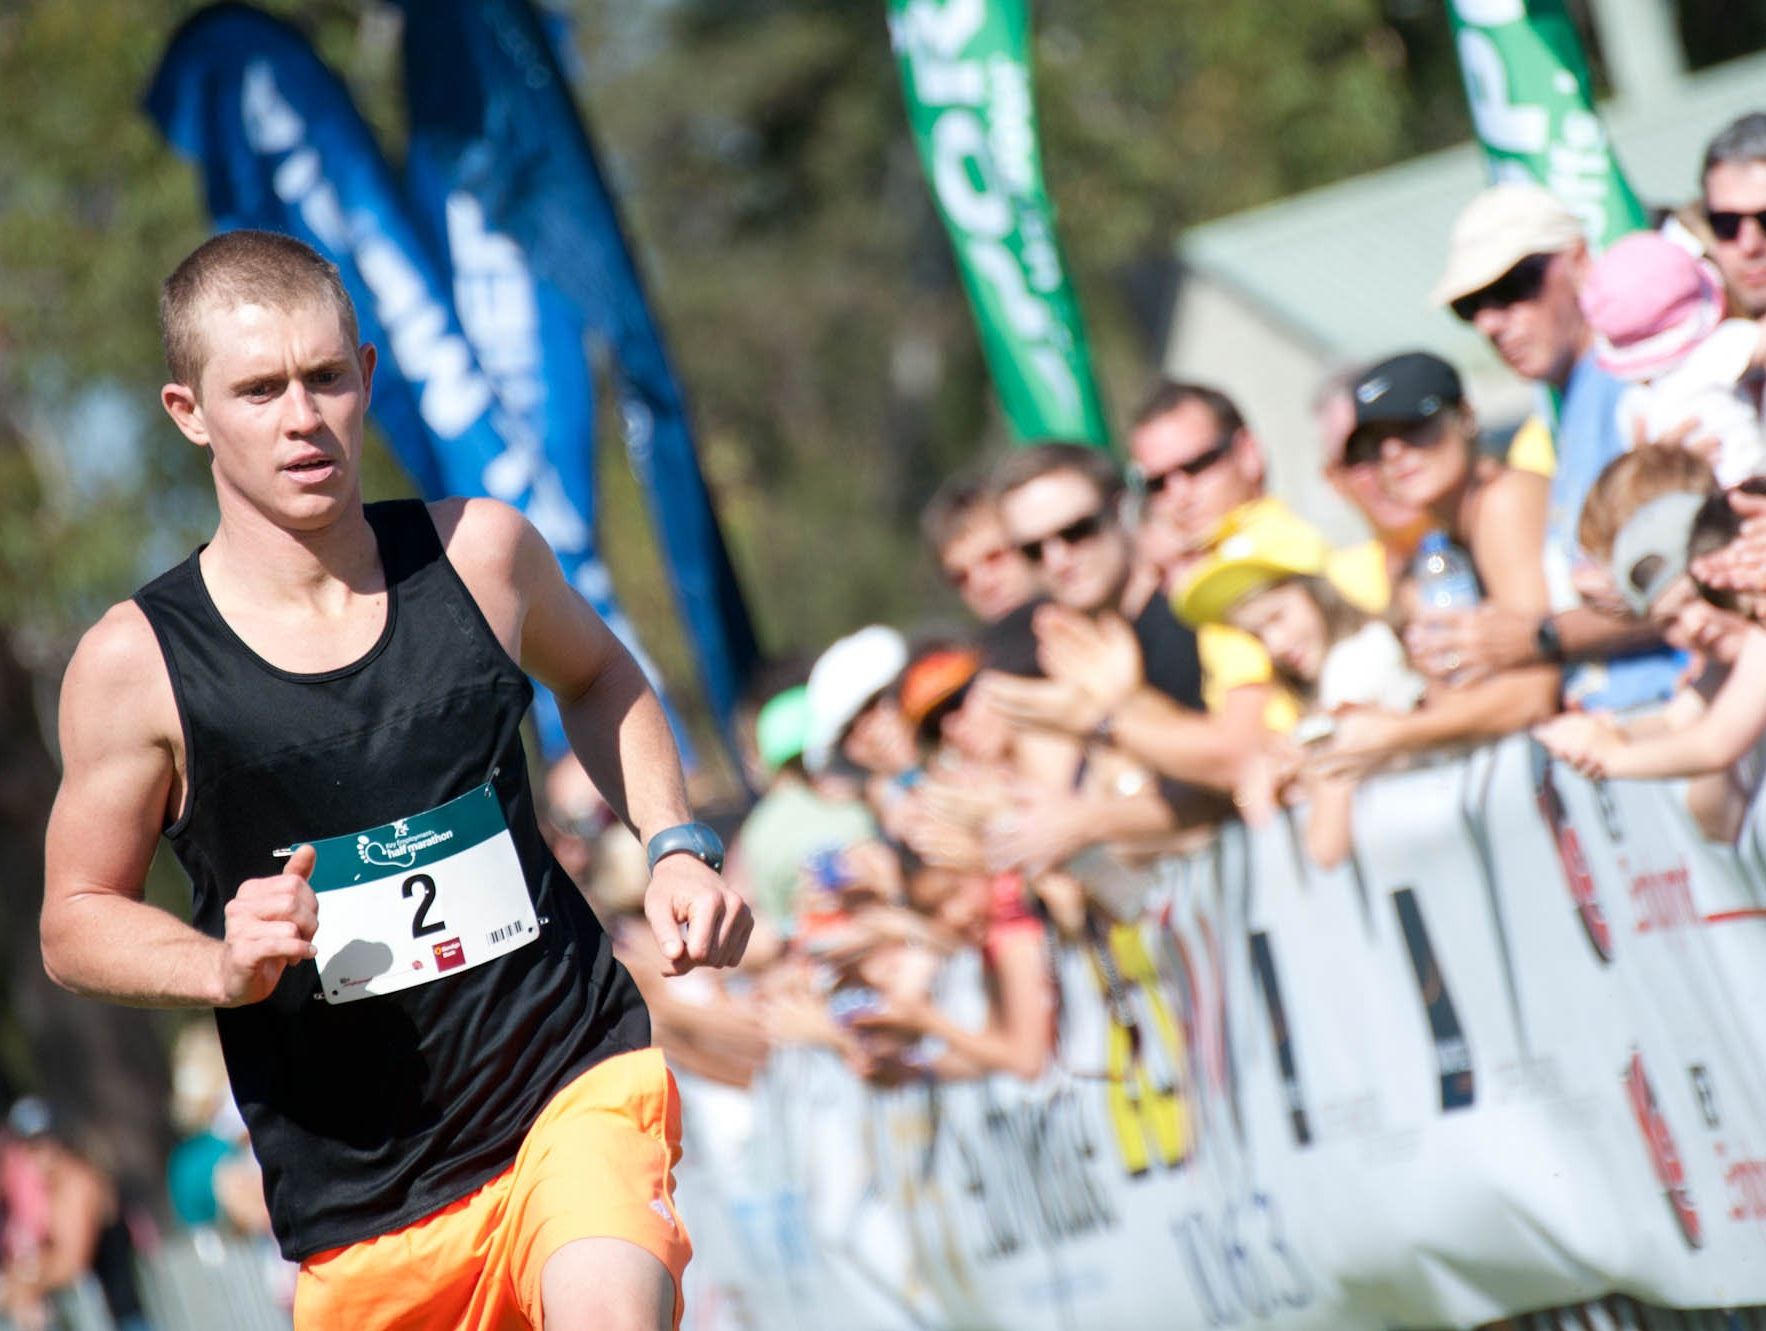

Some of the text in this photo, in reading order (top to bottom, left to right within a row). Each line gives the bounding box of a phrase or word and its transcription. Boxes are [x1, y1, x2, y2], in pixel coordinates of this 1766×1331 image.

[387, 830, 454, 859] half marathon
[402, 874, 446, 938] 2
